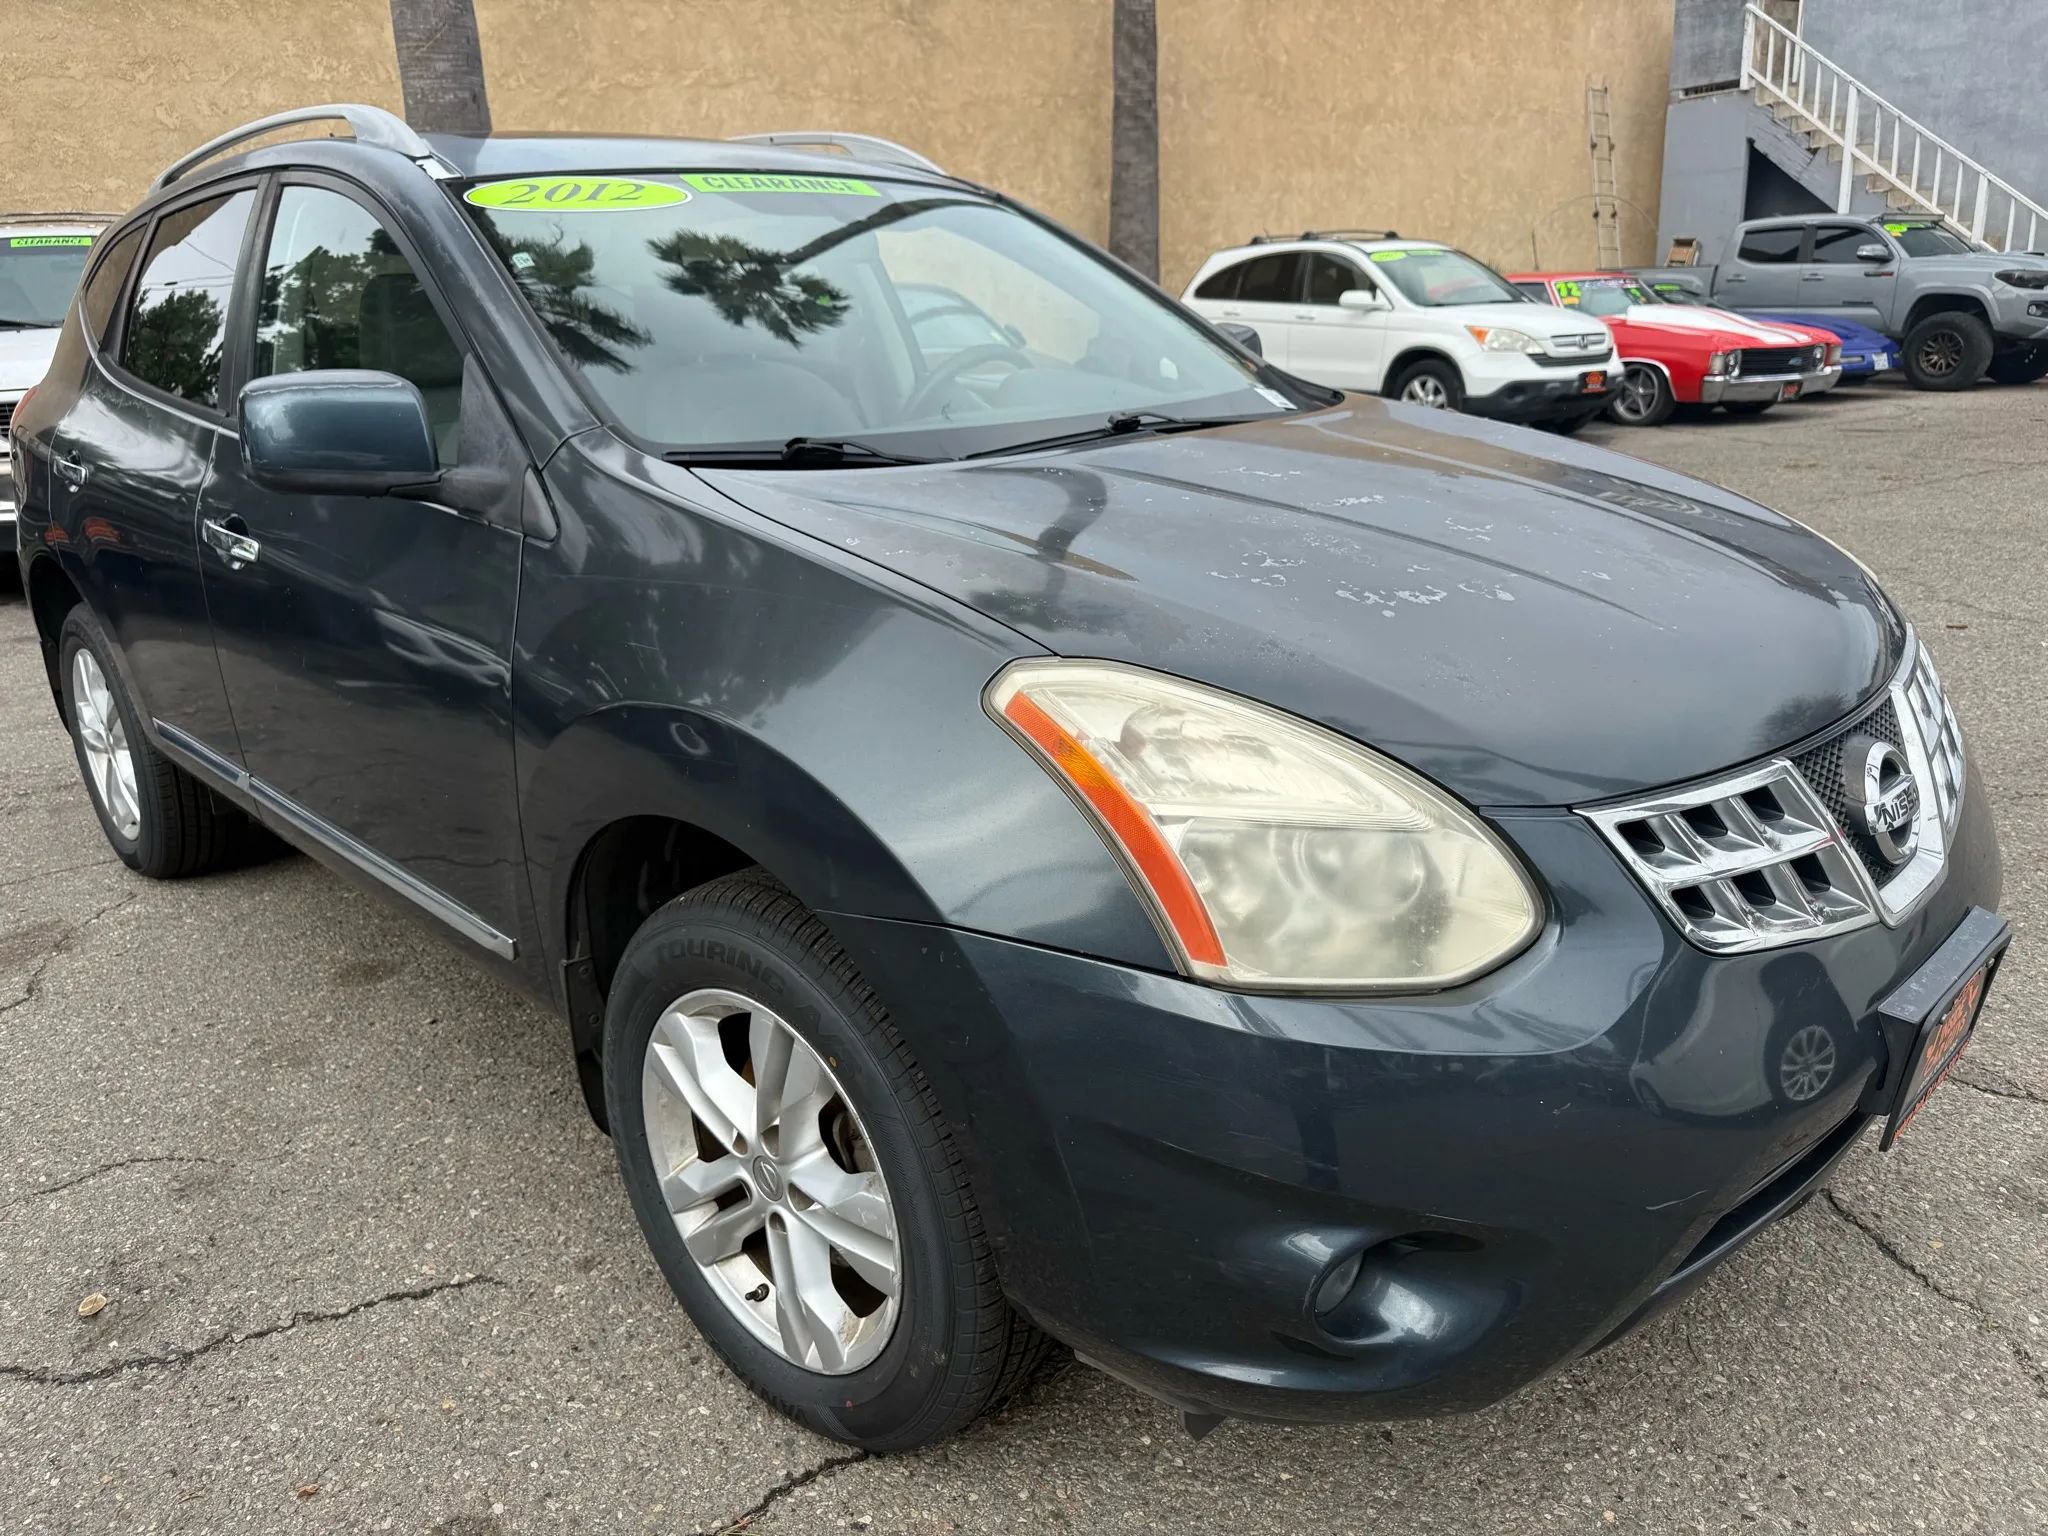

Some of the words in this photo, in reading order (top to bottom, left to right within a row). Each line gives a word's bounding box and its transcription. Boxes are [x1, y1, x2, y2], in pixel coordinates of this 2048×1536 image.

[500, 182, 643, 206] 2012
[704, 174, 859, 193] CLEARANCE
[16, 237, 82, 246] CLEARANCE
[1881, 786, 1920, 826] NISSA
[656, 938, 786, 994] TOURING
